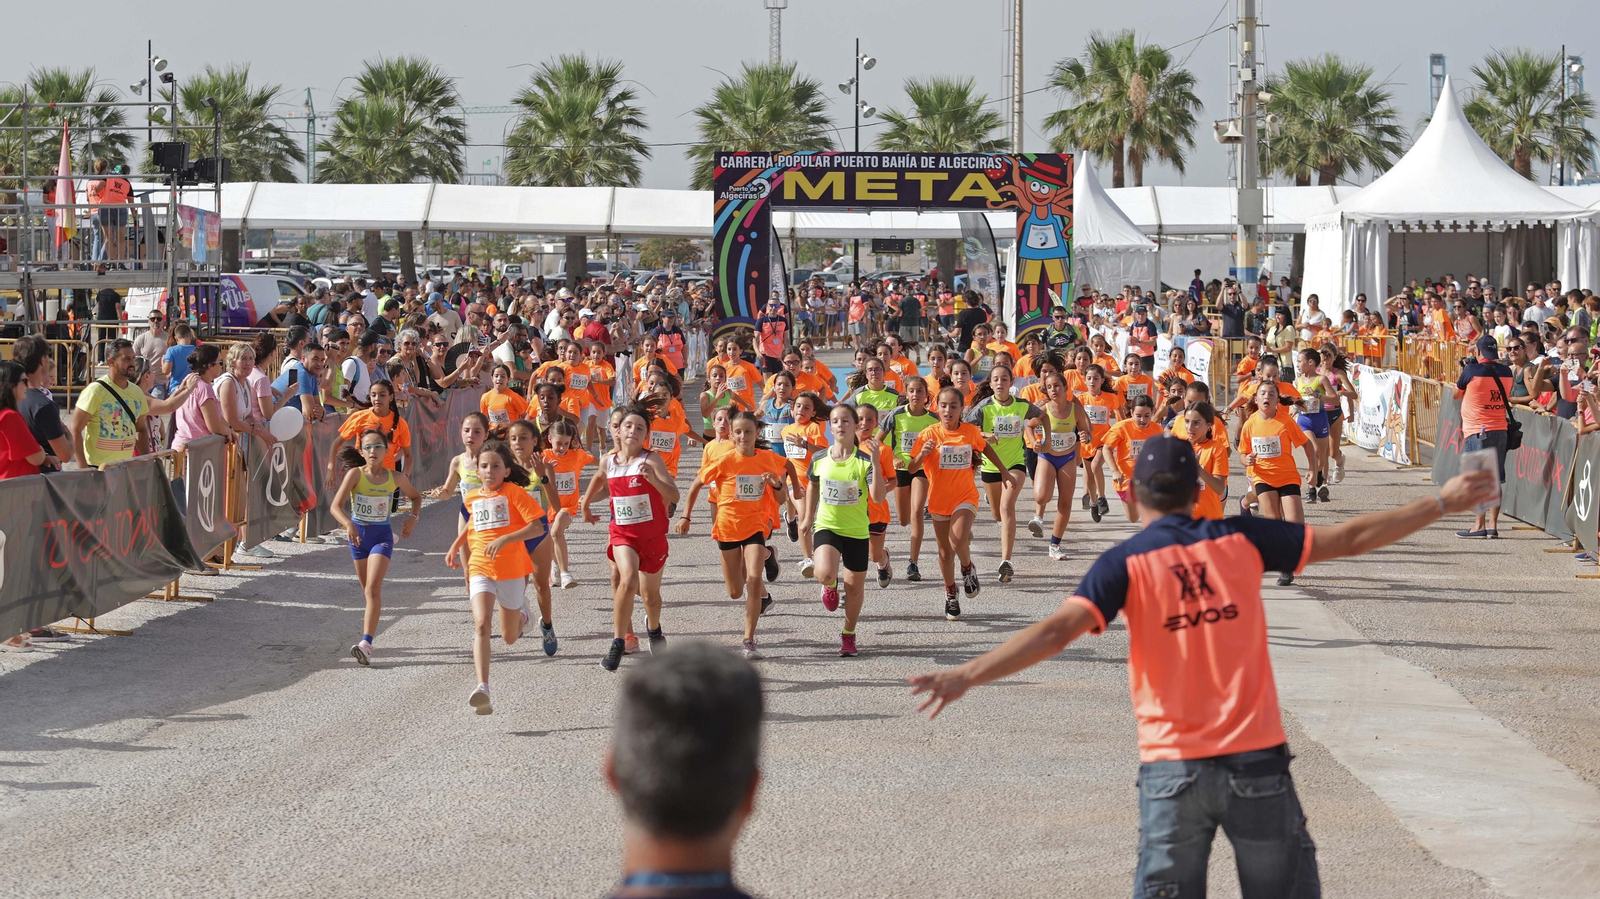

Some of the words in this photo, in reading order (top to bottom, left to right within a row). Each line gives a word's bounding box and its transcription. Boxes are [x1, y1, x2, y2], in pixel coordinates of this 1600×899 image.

[720, 155, 774, 169] CARRERA
[777, 154, 831, 168] POPULAR
[833, 155, 879, 169] PUERTO
[882, 153, 918, 169] BAHÍA
[920, 156, 936, 169] DE
[939, 156, 1003, 170] ALGECIRAS
[728, 185, 749, 193] Puerto
[783, 171, 1004, 202] META
[720, 191, 758, 201] Algeciras
[998, 423, 1013, 432] 849
[651, 437, 669, 447] 1126
[1253, 444, 1271, 453] 1157
[942, 453, 963, 463] 1153
[739, 484, 754, 494] 166
[828, 487, 839, 498] 72
[356, 502, 372, 515] 708
[616, 506, 633, 517] 648
[475, 509, 489, 523] 220
[1163, 604, 1239, 632] EVOS
